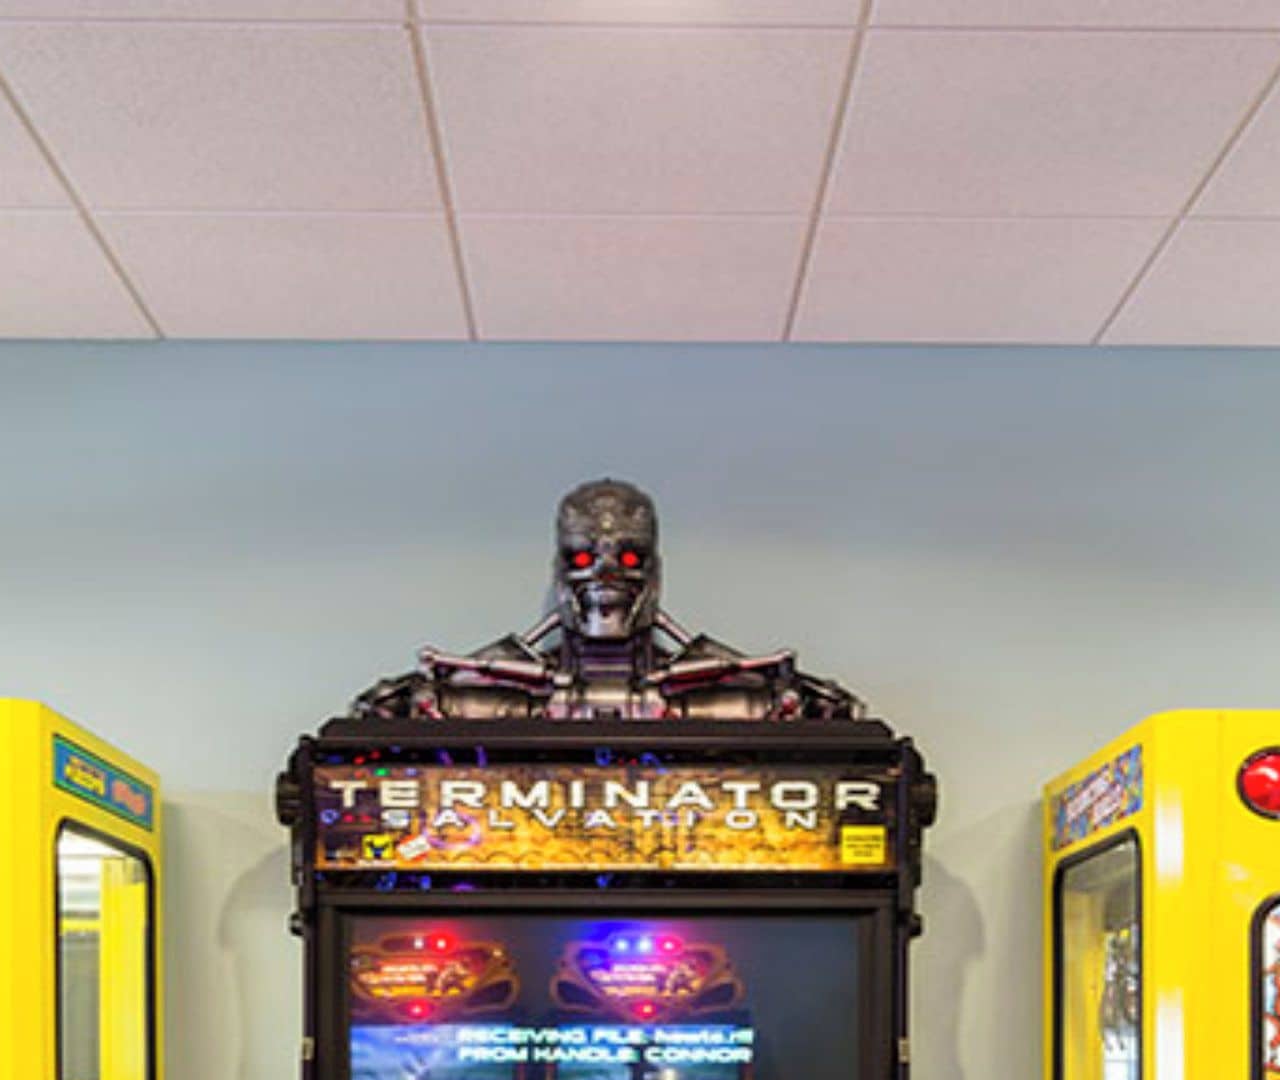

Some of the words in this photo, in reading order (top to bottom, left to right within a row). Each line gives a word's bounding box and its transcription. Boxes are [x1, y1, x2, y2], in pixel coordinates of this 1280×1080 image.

[329, 780, 881, 810] TERMINATOR
[380, 808, 817, 829] SALVATION
[458, 1028, 587, 1045] RECEIVING
[458, 1046, 529, 1063] FROM
[644, 1046, 753, 1063] CONNOR
